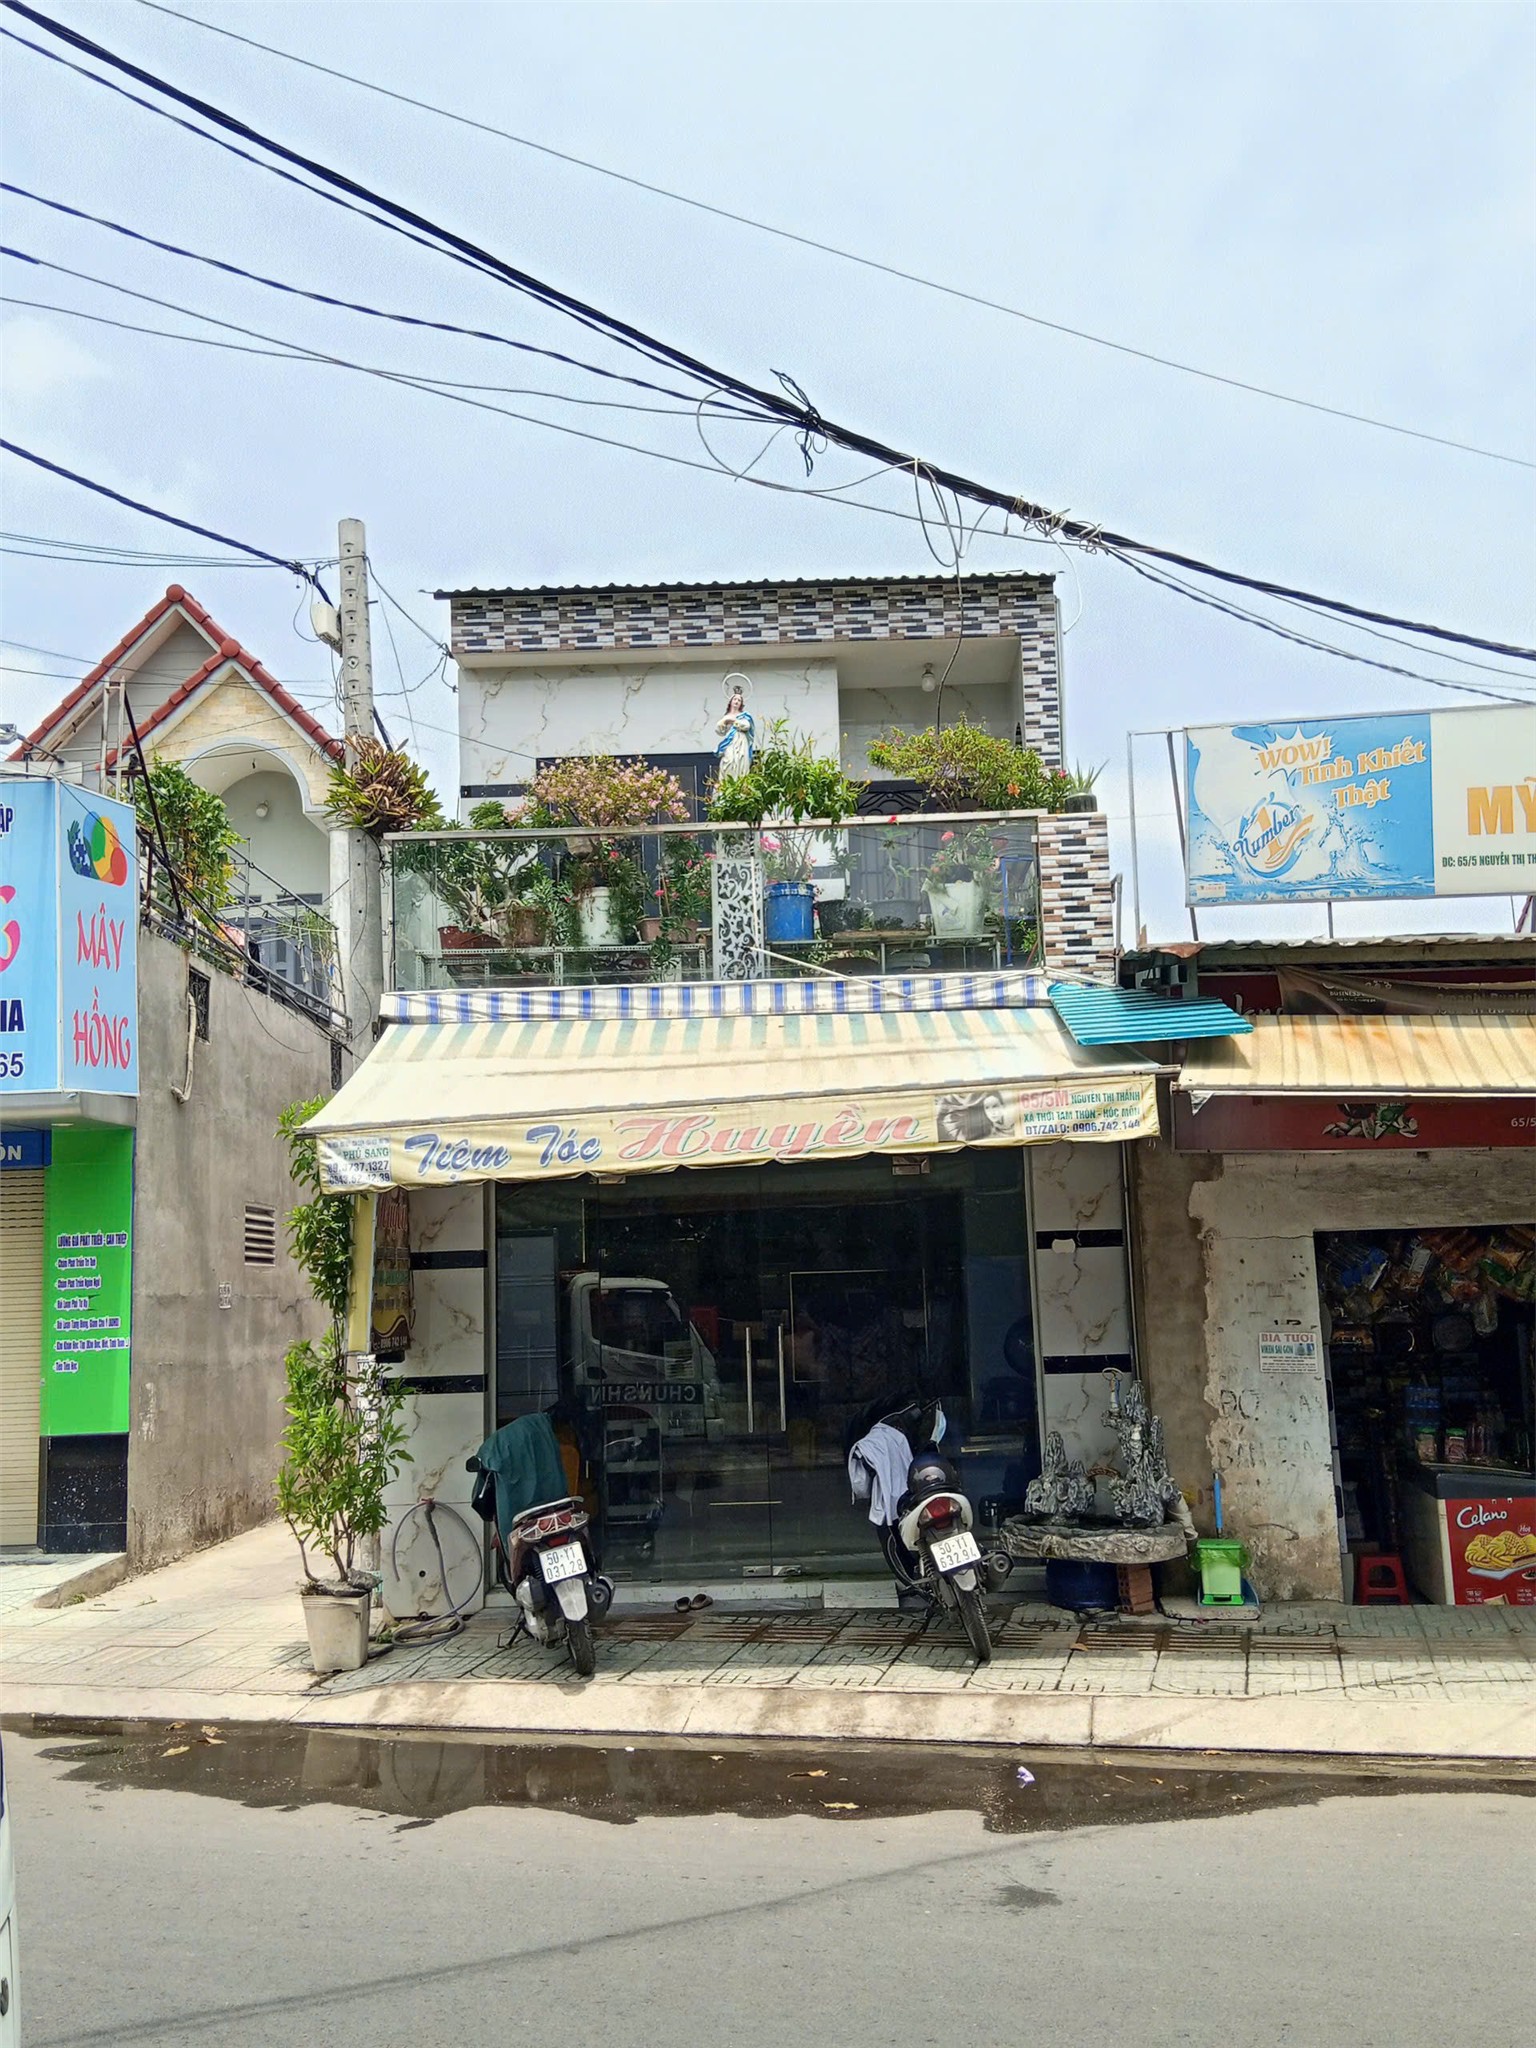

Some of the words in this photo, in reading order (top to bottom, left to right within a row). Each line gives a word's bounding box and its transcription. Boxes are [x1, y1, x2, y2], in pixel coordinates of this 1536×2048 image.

[1258, 737, 1331, 771] WOW!
[1358, 736, 1426, 775] Khiết
[1333, 778, 1391, 808] Thật
[1233, 804, 1300, 859] Number
[1457, 855, 1478, 867] 65/5
[1512, 853, 1525, 867] THỊ
[77, 902, 126, 973] MÂY
[73, 985, 132, 1070] HỒNG
[1020, 1089, 1069, 1109] 65/5M
[364, 1147, 389, 1158] SANG
[404, 1132, 512, 1181] Tiệm
[526, 1124, 603, 1168] Tóc
[613, 1103, 928, 1161] Huyền
[1261, 1333, 1281, 1342] BIA
[1456, 1503, 1508, 1529] Celano
[546, 1546, 577, 1565] 50-Y1
[546, 1559, 585, 1580] 031.28
